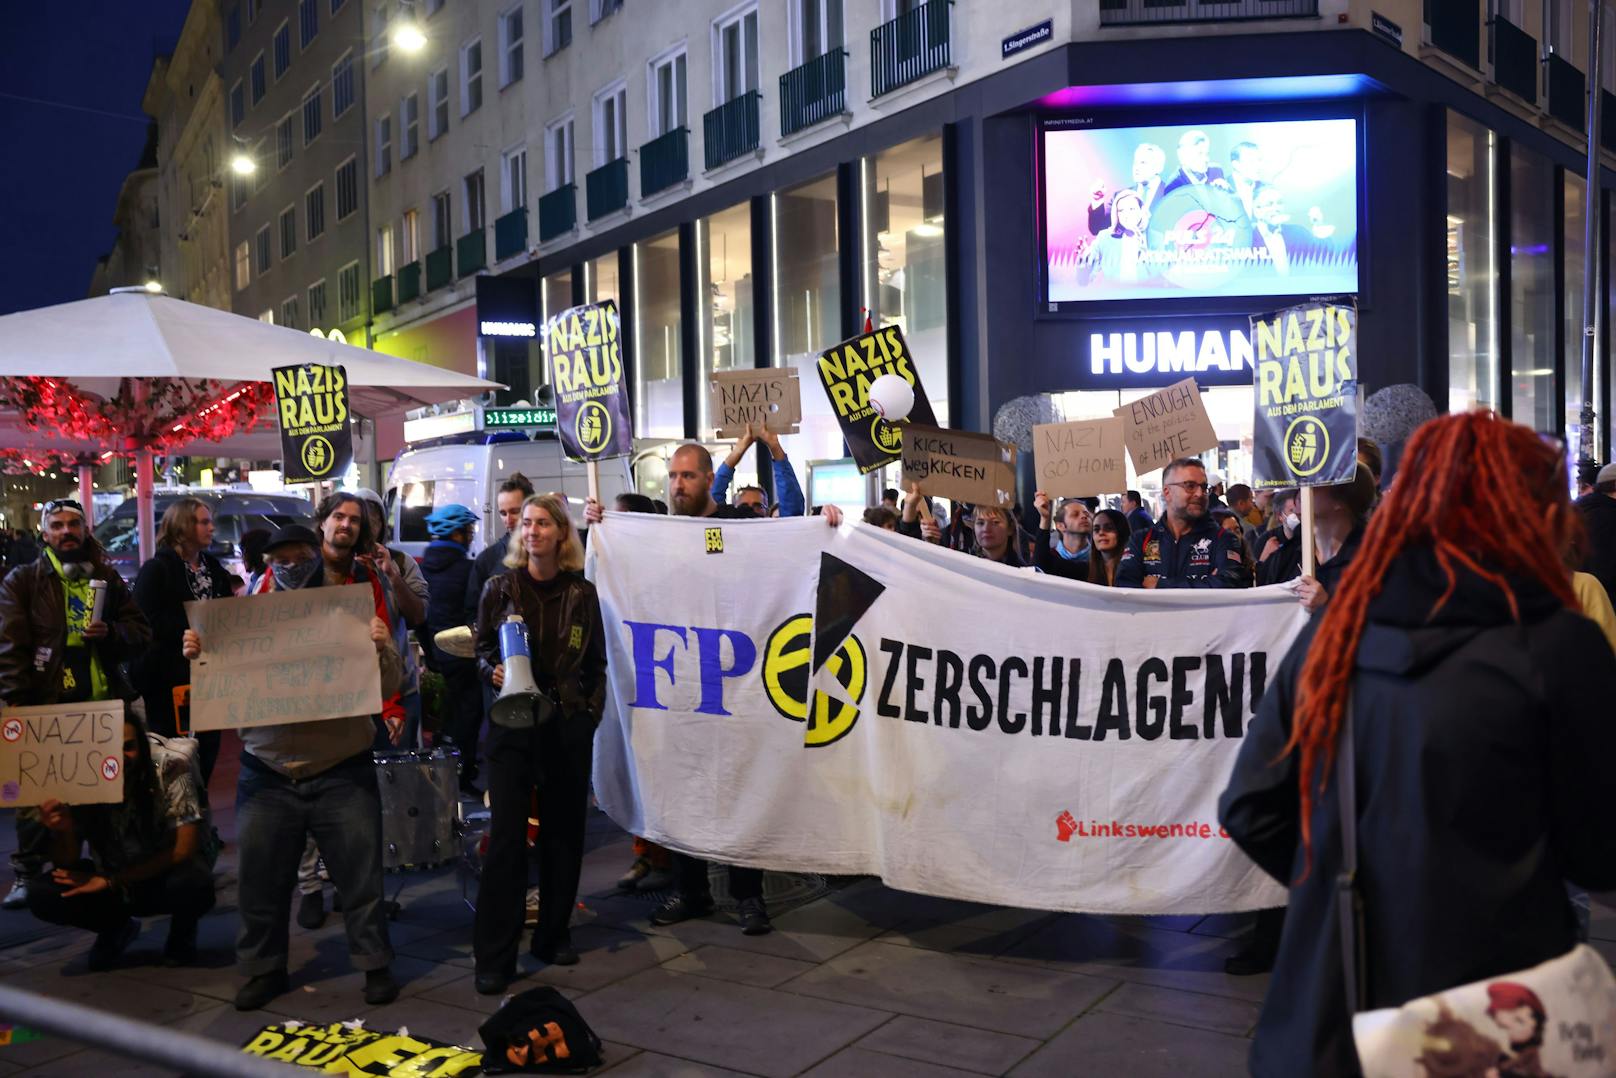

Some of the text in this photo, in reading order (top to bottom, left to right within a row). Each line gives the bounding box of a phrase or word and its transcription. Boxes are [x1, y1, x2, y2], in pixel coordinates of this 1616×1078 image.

[551, 303, 618, 354] NAZIS
[1257, 306, 1351, 360] NAZIS
[553, 341, 621, 394] RAUS
[818, 328, 903, 386] NAZIS
[275, 366, 345, 398] NAZIS
[721, 381, 783, 405] NAZIS
[1259, 346, 1352, 406] RAUS
[280, 391, 347, 429] RAUS
[849, 412, 862, 423] AUS
[1131, 385, 1195, 425] ENOUGH
[1267, 396, 1345, 417] AUS DEM PARLAMENT
[914, 437, 957, 455] KICKL
[1044, 427, 1104, 453] NAZI
[1153, 430, 1191, 461] HATE
[1043, 457, 1120, 479] GO HOME
[877, 637, 1267, 741] ZERSCHLAGEN!
[24, 712, 114, 745] NAZIS
[18, 750, 102, 788] RAUS
